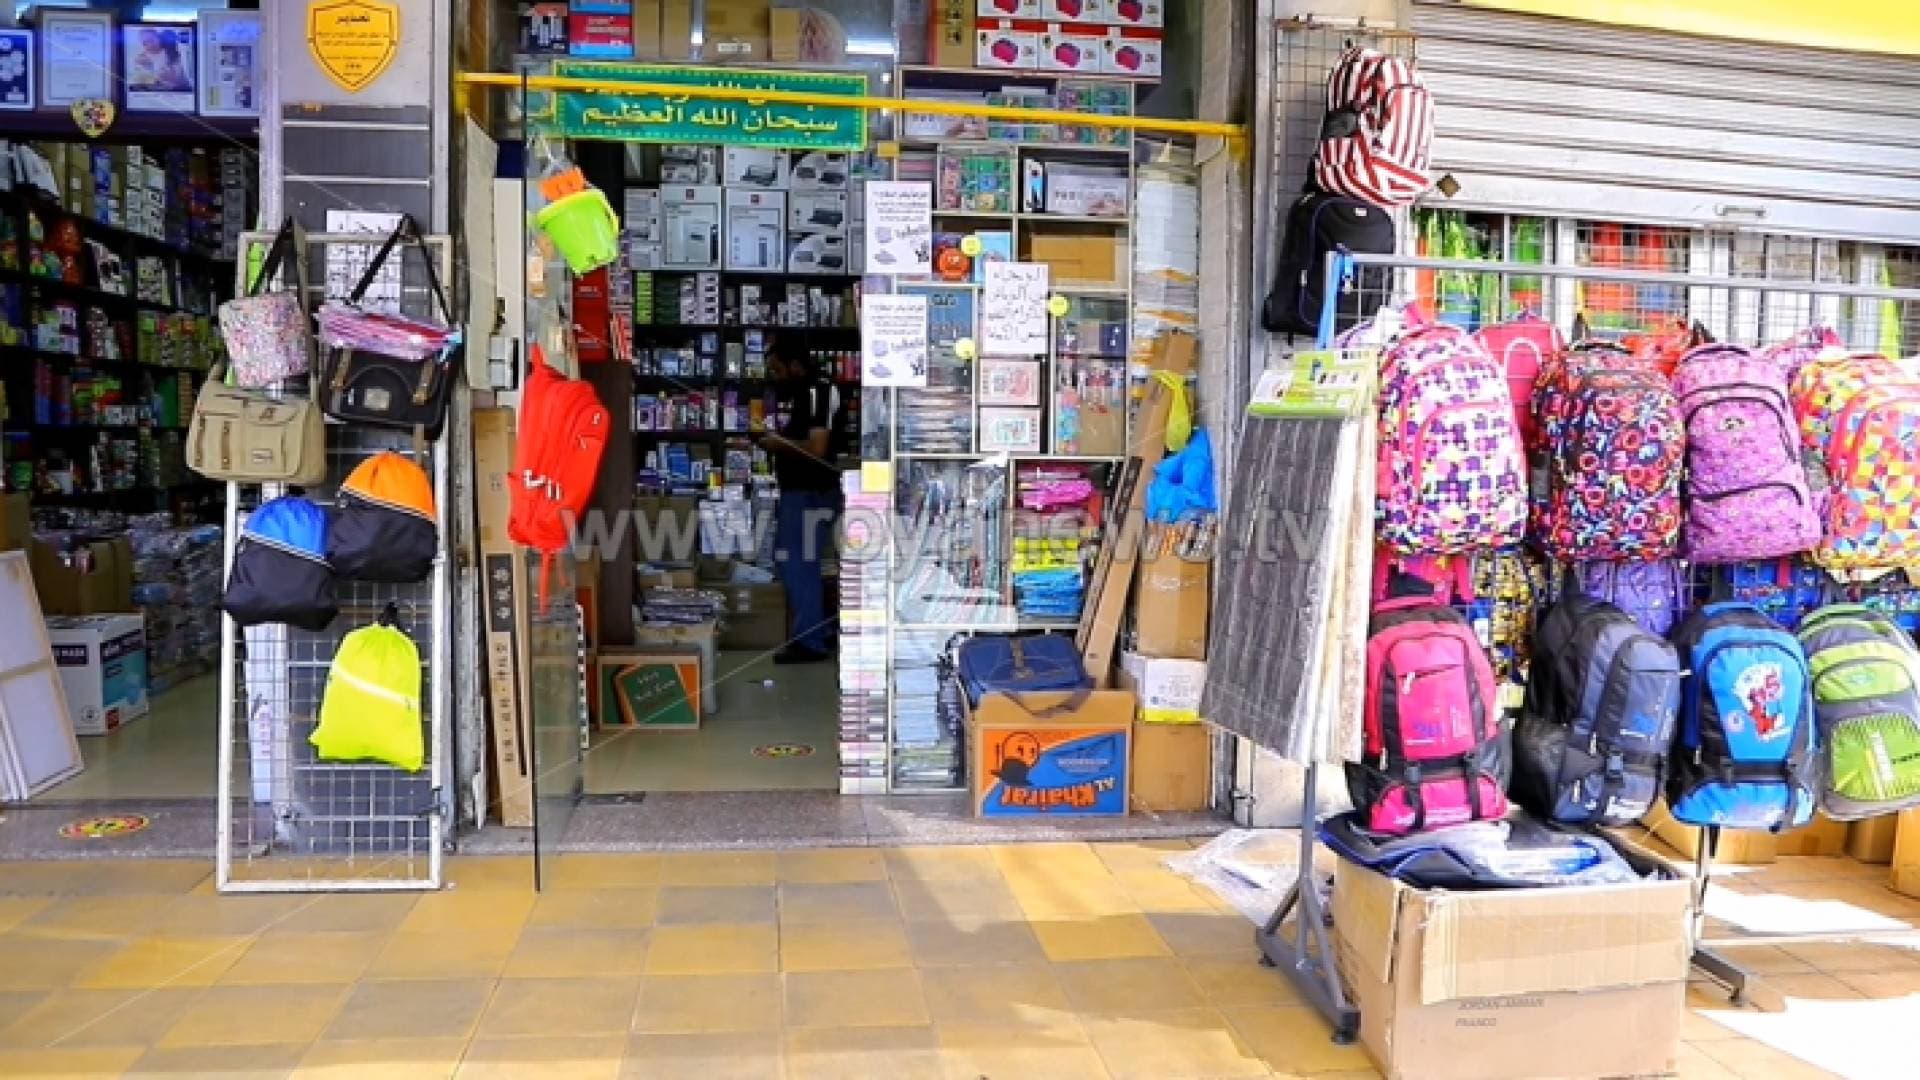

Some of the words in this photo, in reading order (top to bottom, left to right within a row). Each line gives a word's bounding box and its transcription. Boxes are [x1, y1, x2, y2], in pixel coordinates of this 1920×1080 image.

[582, 101, 685, 127] العظيم
[690, 104, 738, 126] الله
[742, 107, 839, 137] سبحان
